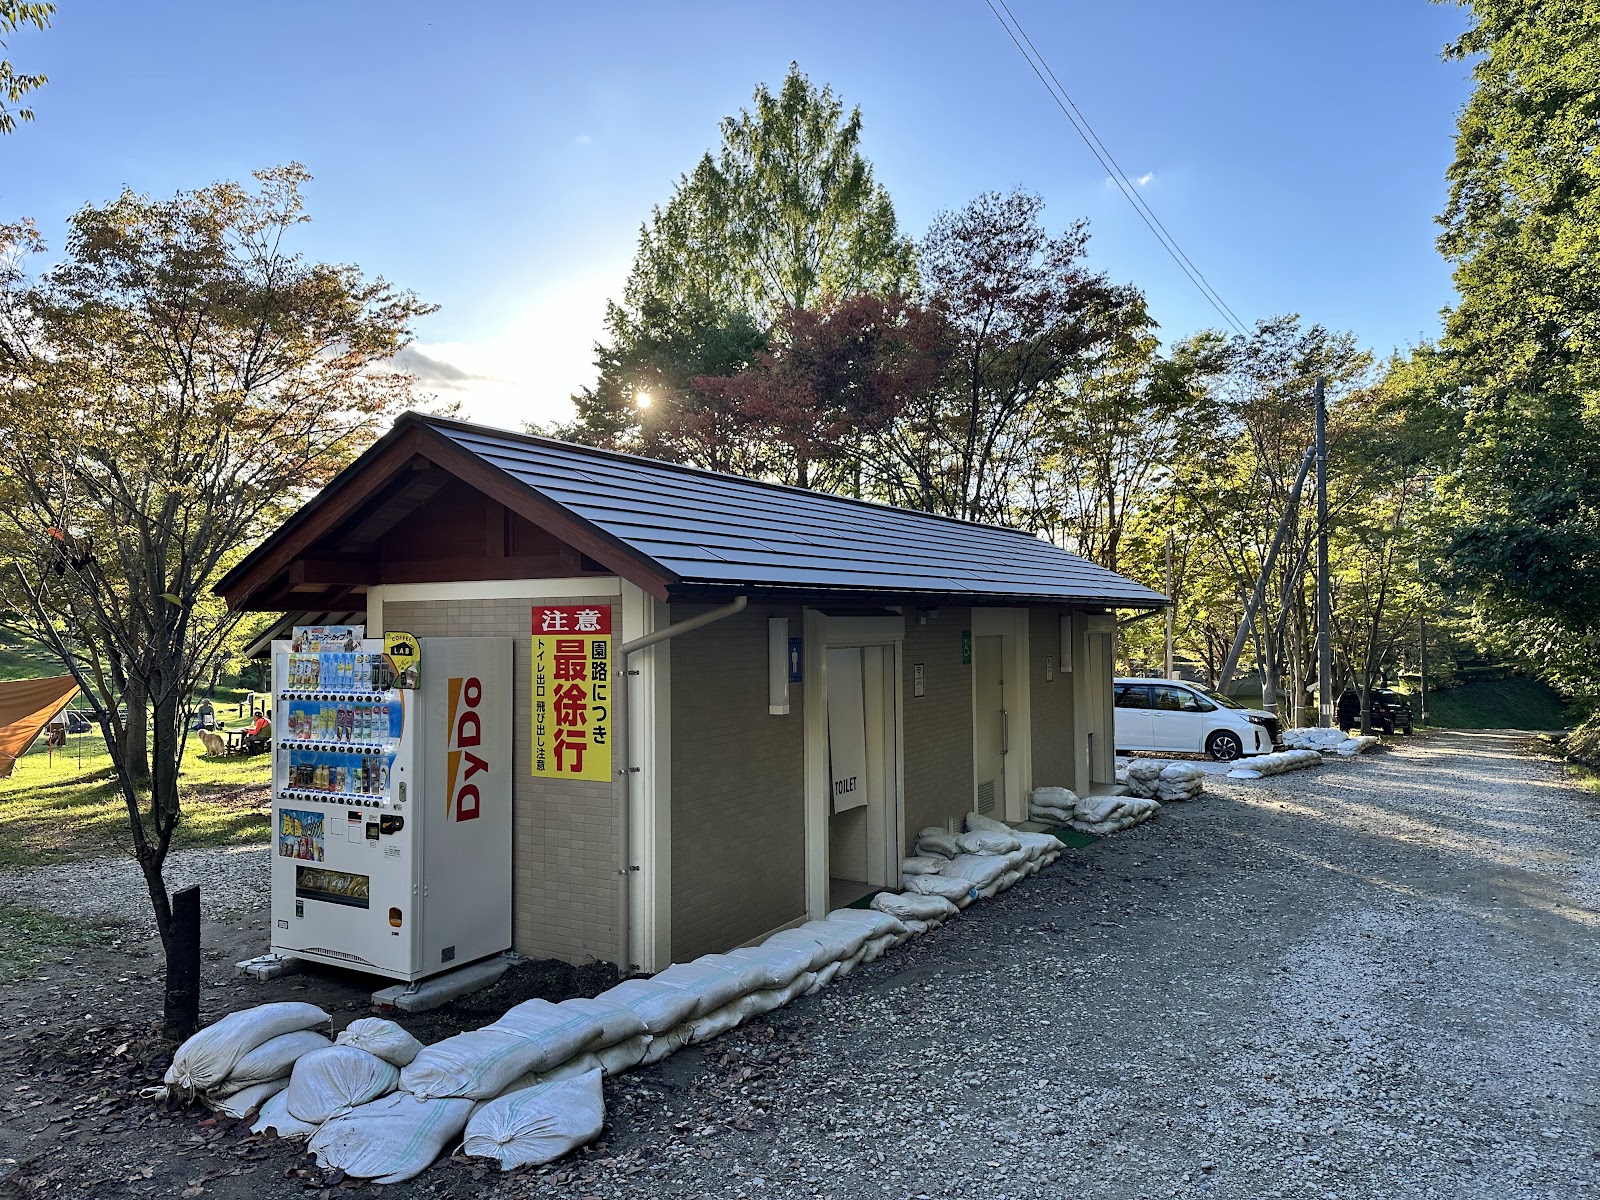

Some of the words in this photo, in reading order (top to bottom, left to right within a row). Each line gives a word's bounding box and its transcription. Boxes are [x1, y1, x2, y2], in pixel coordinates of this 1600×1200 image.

[391, 635, 412, 643] COFFEE
[541, 609, 601, 632] 注意
[394, 647, 410, 655] LAB
[536, 639, 545, 697] トイレ出口
[553, 639, 588, 773] 最徐行
[591, 640, 608, 745] 園路につき
[536, 700, 546, 771] 飛び出し注意
[835, 776, 857, 796] TOILET
